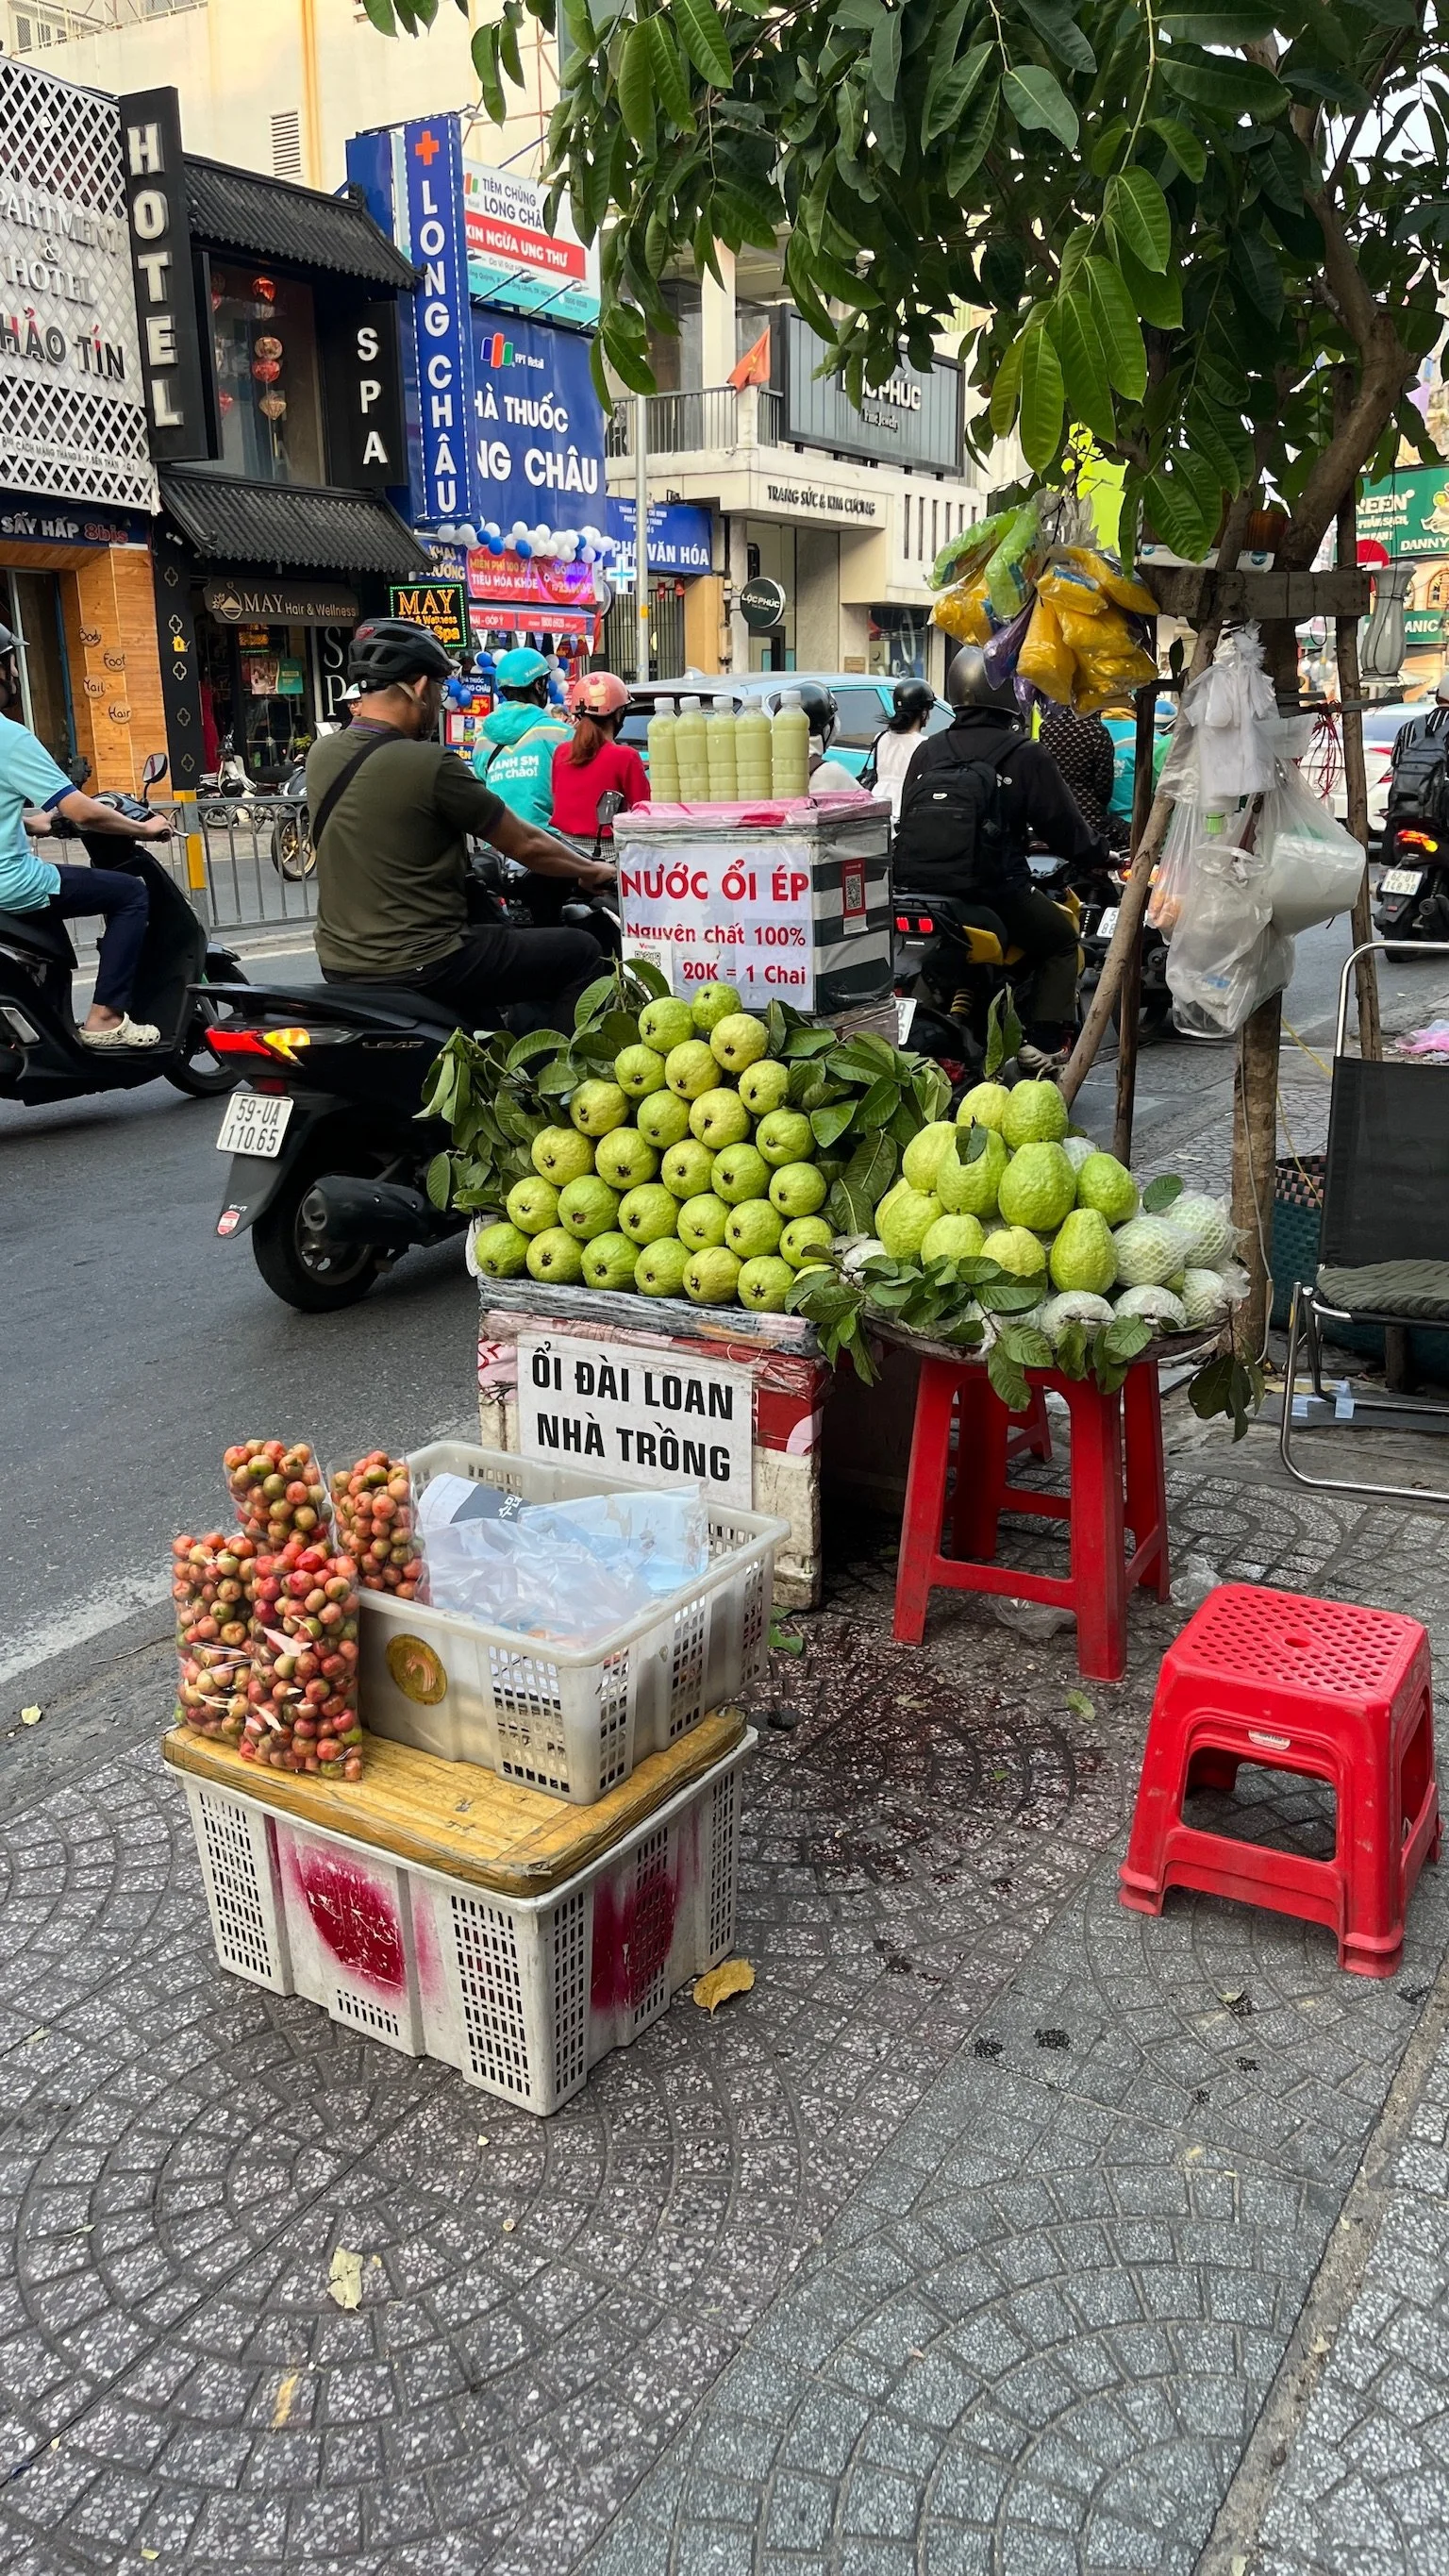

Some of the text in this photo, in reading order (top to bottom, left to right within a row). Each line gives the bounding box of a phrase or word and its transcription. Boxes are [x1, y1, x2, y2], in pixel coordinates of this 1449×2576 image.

[482, 177, 503, 195] TIÊM
[484, 195, 516, 220] LONG
[518, 210, 544, 229] CHÂ
[40, 237, 58, 264] &
[486, 229, 520, 254] NGỪA
[544, 248, 569, 268] THƯ
[5, 255, 96, 306] HOTEL
[127, 124, 183, 427] HOTEL
[74, 325, 126, 380] TÍN
[420, 180, 458, 512] LONG CHÂU
[514, 353, 526, 365] FPT
[357, 327, 389, 464] SPA
[504, 392, 569, 434] THUỐC
[525, 445, 599, 494] CHÂU
[767, 485, 799, 504] TRANG
[800, 486, 819, 508] SỨC
[819, 493, 826, 509] &
[827, 495, 843, 510] KIM
[0, 510, 130, 544] SẤY HẤP 8bis
[646, 541, 676, 563] VĂN
[680, 544, 709, 566] HÓA
[472, 572, 491, 586] TIÊU
[243, 593, 356, 617] MAY Hair & Wellness
[398, 589, 455, 615] MAY
[758, 596, 781, 609] PHÚC
[78, 627, 102, 646] Body
[104, 652, 126, 667] Foot
[108, 706, 131, 719] Hair
[505, 765, 538, 778] chào!
[520, 755, 539, 766] SM
[621, 860, 809, 901] NƯỚC ỔI ÉP
[626, 922, 807, 946] Nguyên chất 100%
[683, 962, 807, 985] 20K = 1 Chai
[237, 1099, 282, 1126] 59-UA
[226, 1125, 279, 1152] 110.65
[532, 1340, 733, 1420] ỔI ĐÀI LOAN
[537, 1412, 730, 1481] NHÀ TRỒNG
